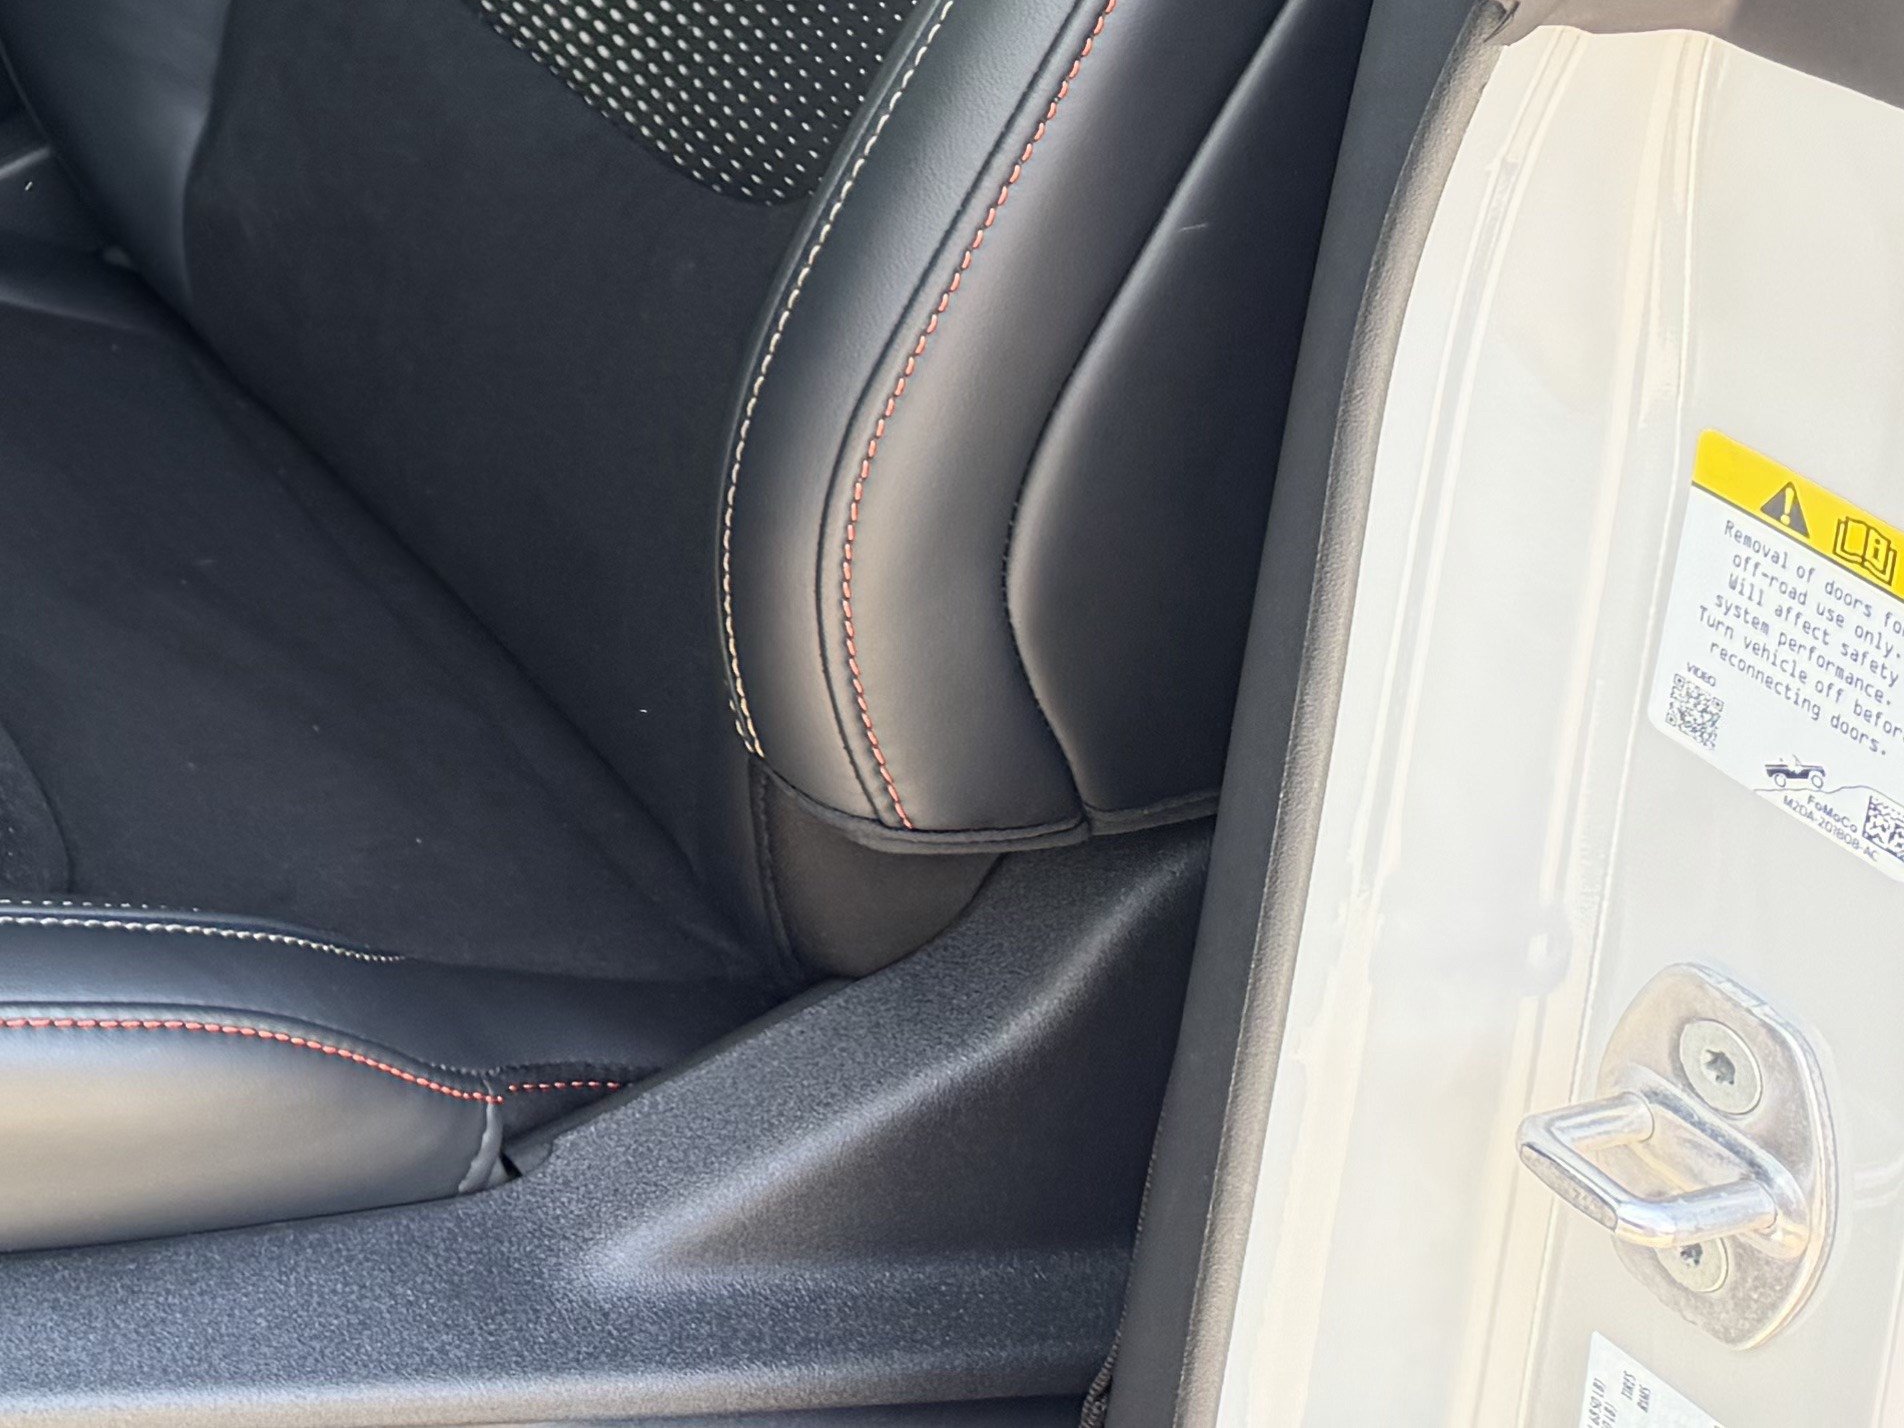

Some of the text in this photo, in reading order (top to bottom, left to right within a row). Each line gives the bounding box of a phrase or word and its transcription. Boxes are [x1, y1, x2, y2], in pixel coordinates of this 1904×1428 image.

[1724, 519, 1789, 569] Removal
[1796, 564, 1815, 584] of
[1824, 580, 1873, 618] doors
[1732, 553, 1902, 659] off-road use only.
[1686, 661, 1717, 687] VIDEO
[1699, 604, 1904, 744] Turn vehicle off befor
[1715, 594, 1891, 706] system performance.
[1728, 572, 1899, 688] Will affect safety
[1711, 641, 1887, 756] reconnecting doors.
[1806, 793, 1858, 834] FoMoCo
